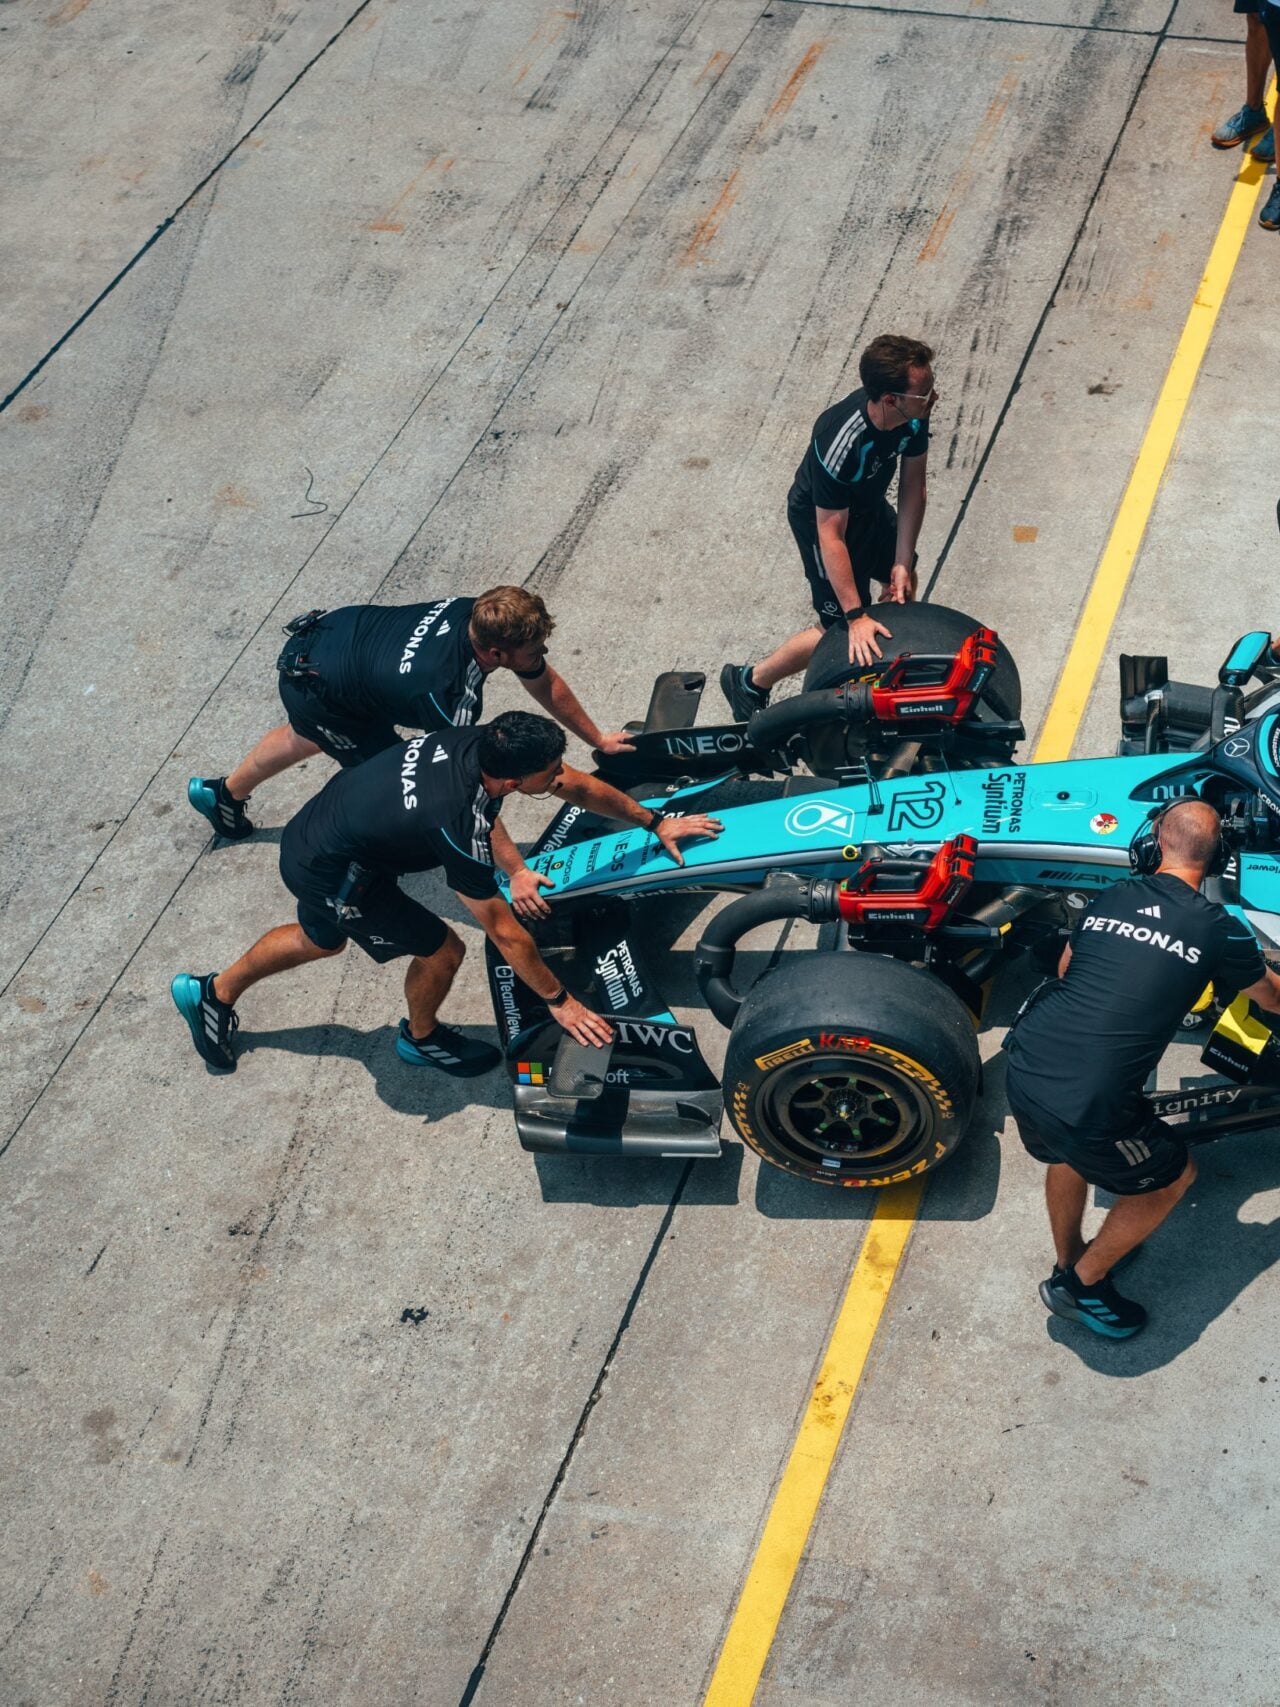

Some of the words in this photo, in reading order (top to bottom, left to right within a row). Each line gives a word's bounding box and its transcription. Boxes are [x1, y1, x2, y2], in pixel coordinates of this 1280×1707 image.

[900, 704, 944, 716] Einhell
[401, 731, 437, 811] RONAS
[1152, 783, 1186, 801] nu
[888, 781, 946, 832] 12
[981, 773, 1012, 835] Syntium
[1008, 772, 1027, 833] PETRONAS
[1082, 916, 1202, 964] PETRONAS
[595, 949, 629, 1011] Syntium
[617, 940, 643, 998] PETRONAS
[616, 1022, 694, 1054] IWC
[755, 1038, 815, 1071] PIRELLI
[1153, 1087, 1243, 1117] ignify
